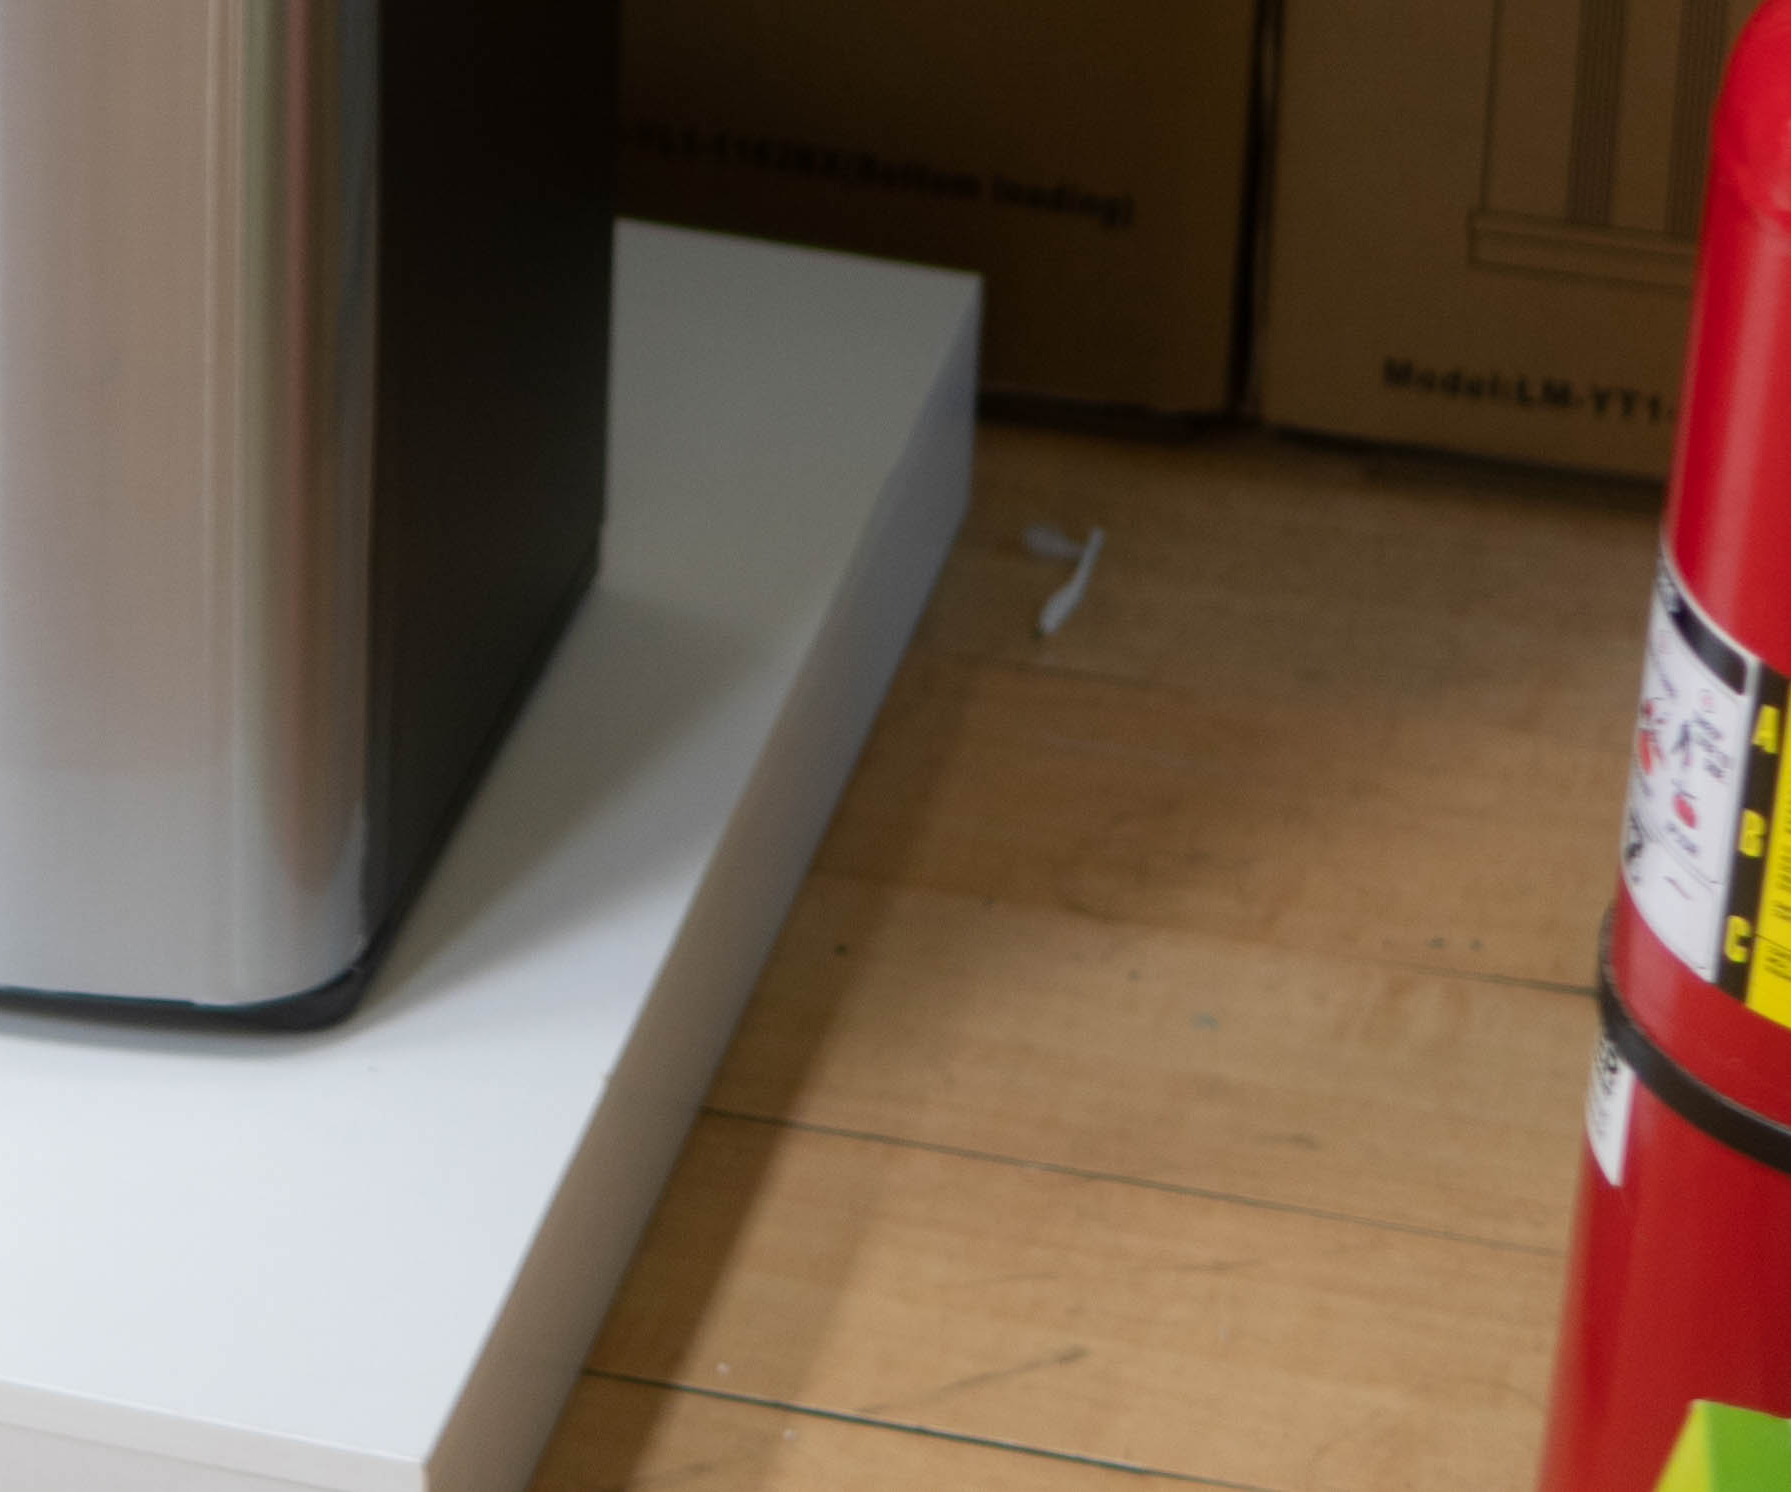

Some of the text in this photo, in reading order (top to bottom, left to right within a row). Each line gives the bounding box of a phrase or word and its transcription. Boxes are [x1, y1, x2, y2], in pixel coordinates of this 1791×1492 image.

[1752, 706, 1780, 755] A
[1737, 810, 1766, 858] B
[1724, 915, 1752, 965] C
